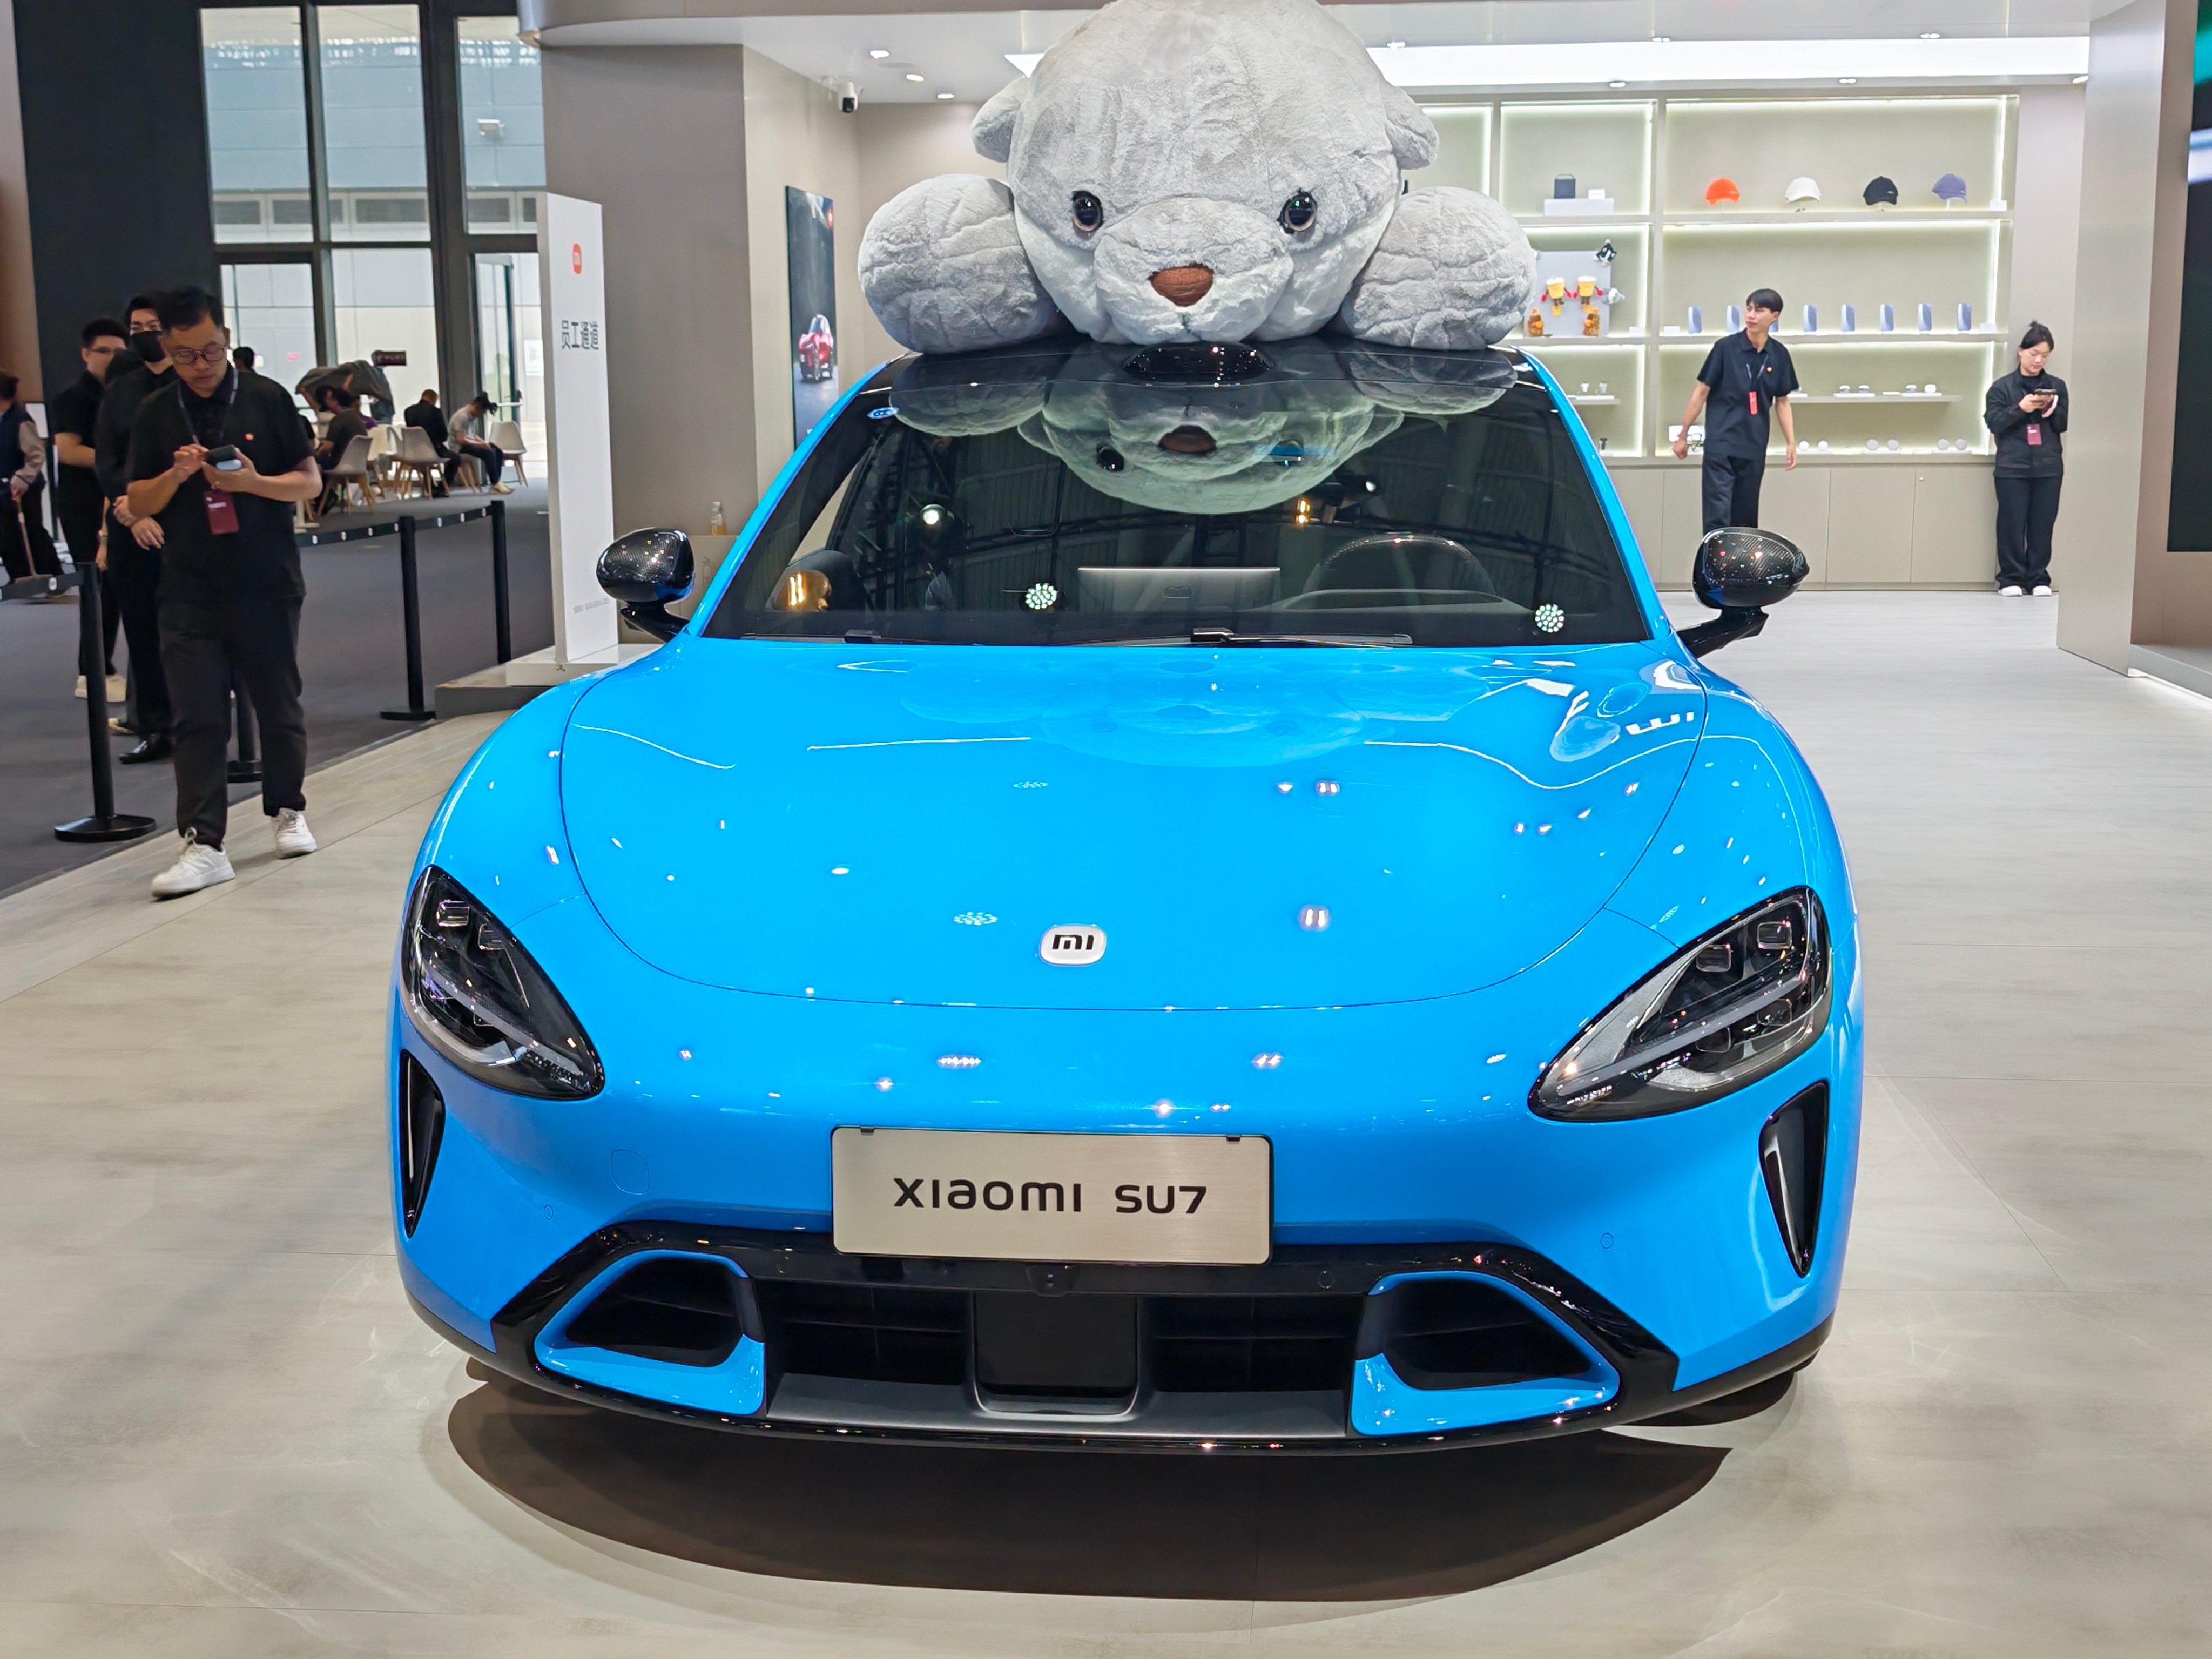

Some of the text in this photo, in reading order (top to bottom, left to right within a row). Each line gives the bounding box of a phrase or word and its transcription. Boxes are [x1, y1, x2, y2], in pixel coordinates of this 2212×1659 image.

[562, 320, 599, 350] 员工通道
[1115, 1184, 1208, 1215] SU7
